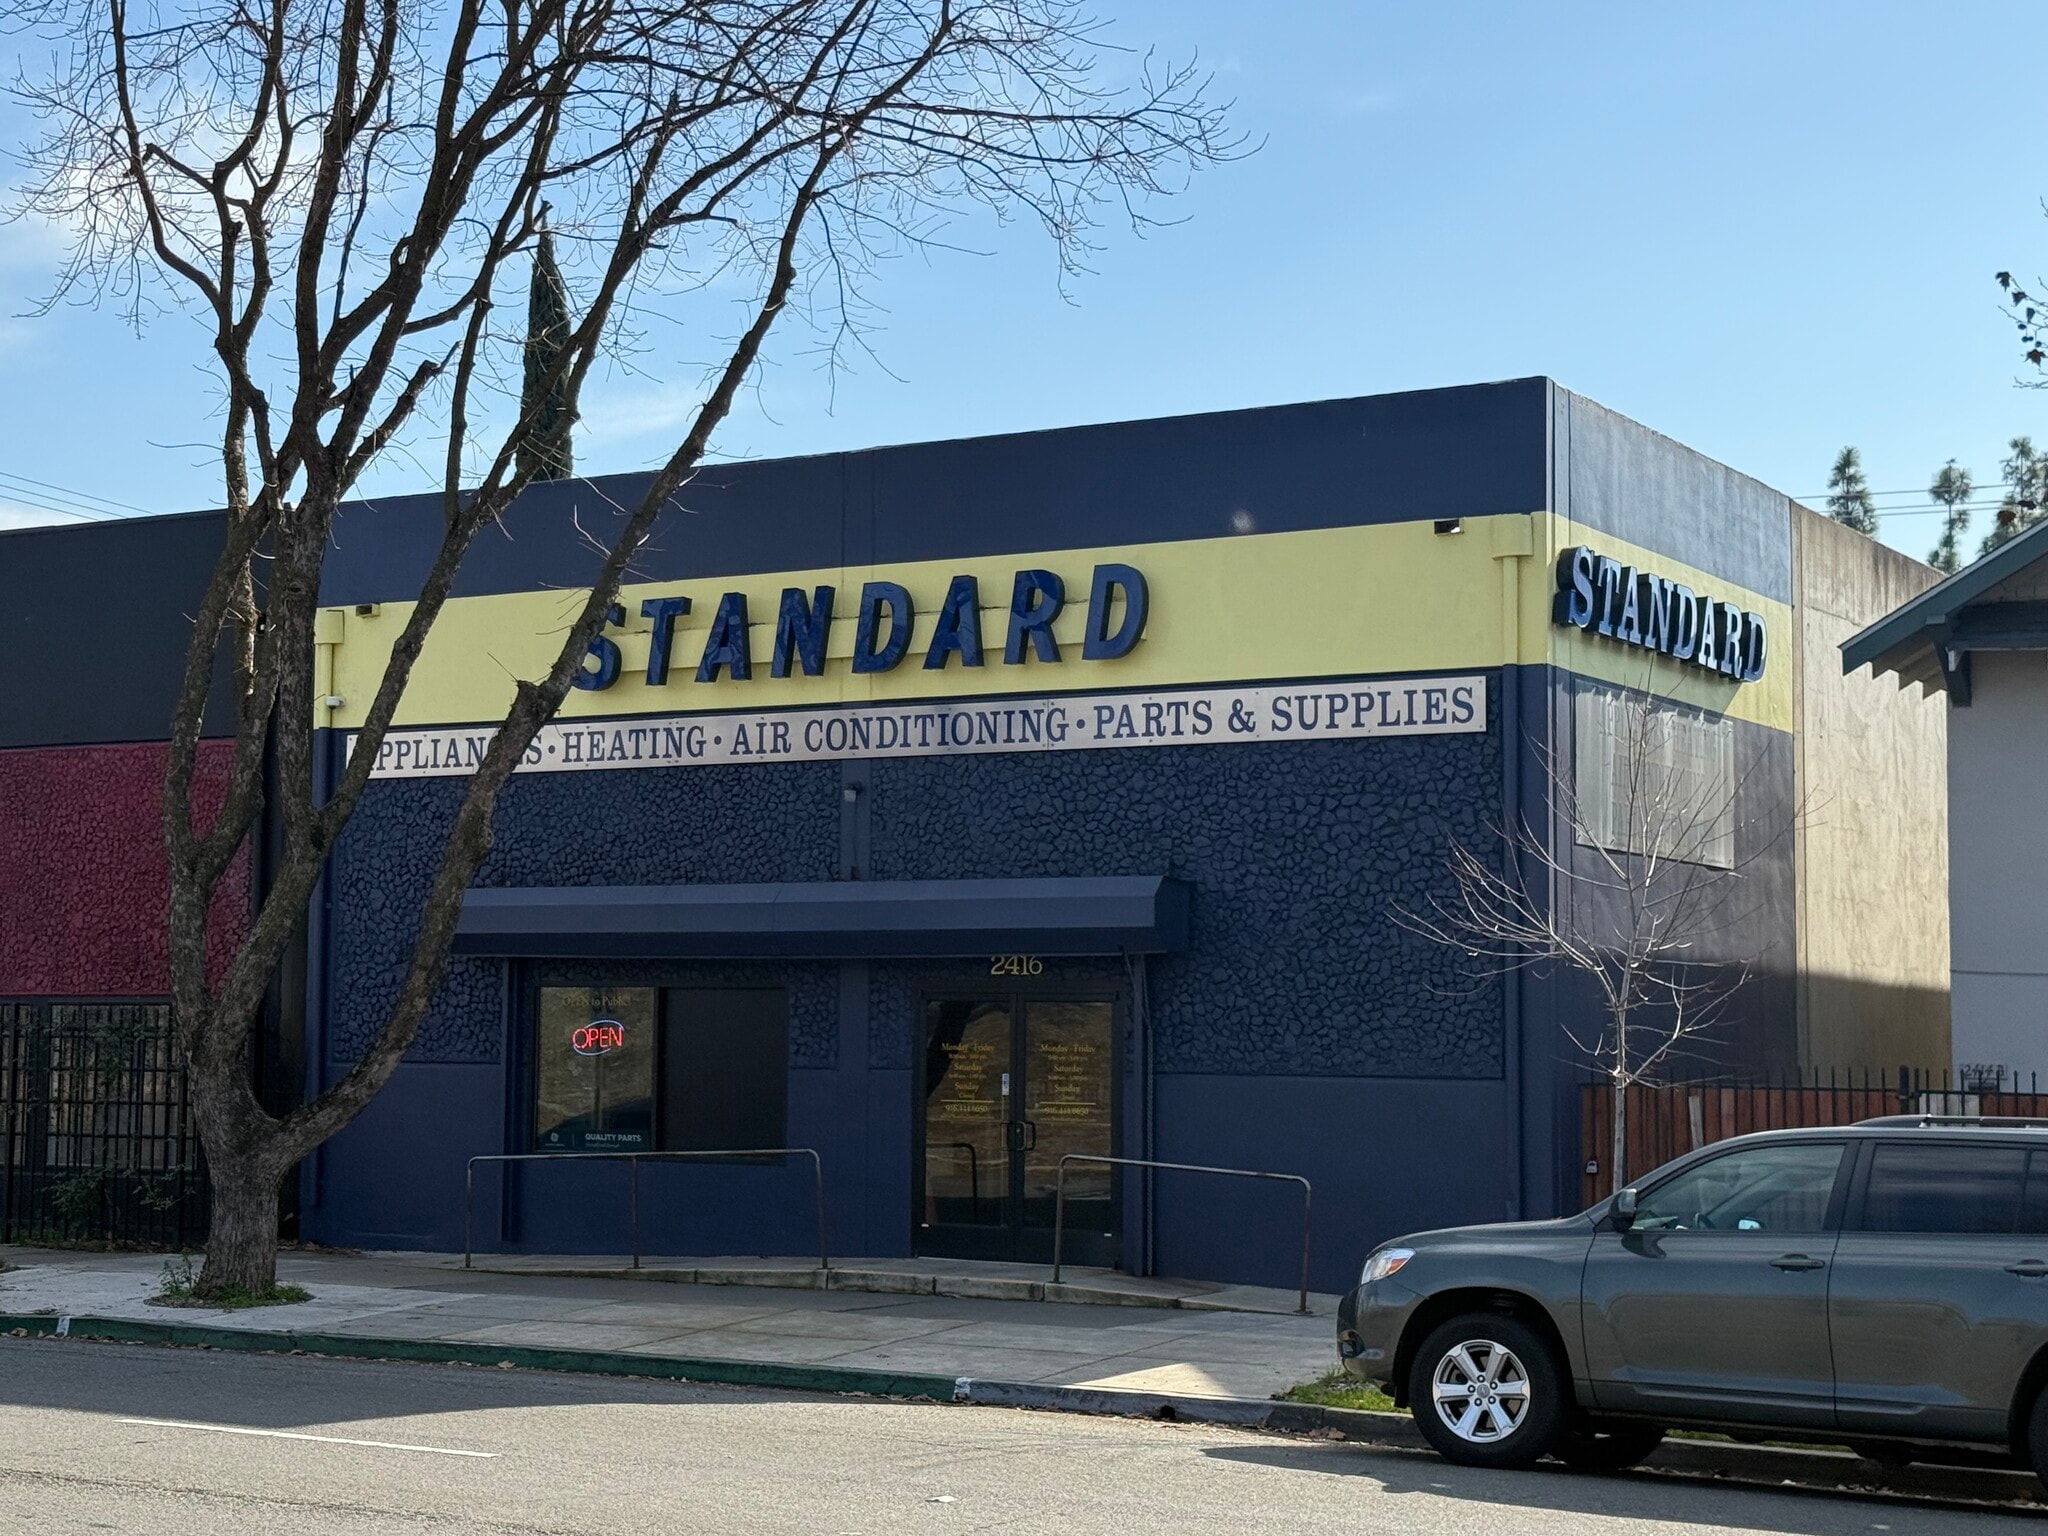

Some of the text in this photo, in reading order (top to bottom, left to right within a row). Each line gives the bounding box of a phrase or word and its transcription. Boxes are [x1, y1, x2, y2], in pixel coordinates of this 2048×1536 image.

[573, 563, 1150, 691] STANDARD
[1552, 545, 1768, 683] STANDARD
[370, 686, 1476, 771] PPLIANS HEATING AIR CONDITIONING PARTS & SUPPLIES
[991, 954, 1043, 975] 2416
[572, 1027, 623, 1049] OPEN
[584, 1132, 642, 1143] QUALITY PARTS
